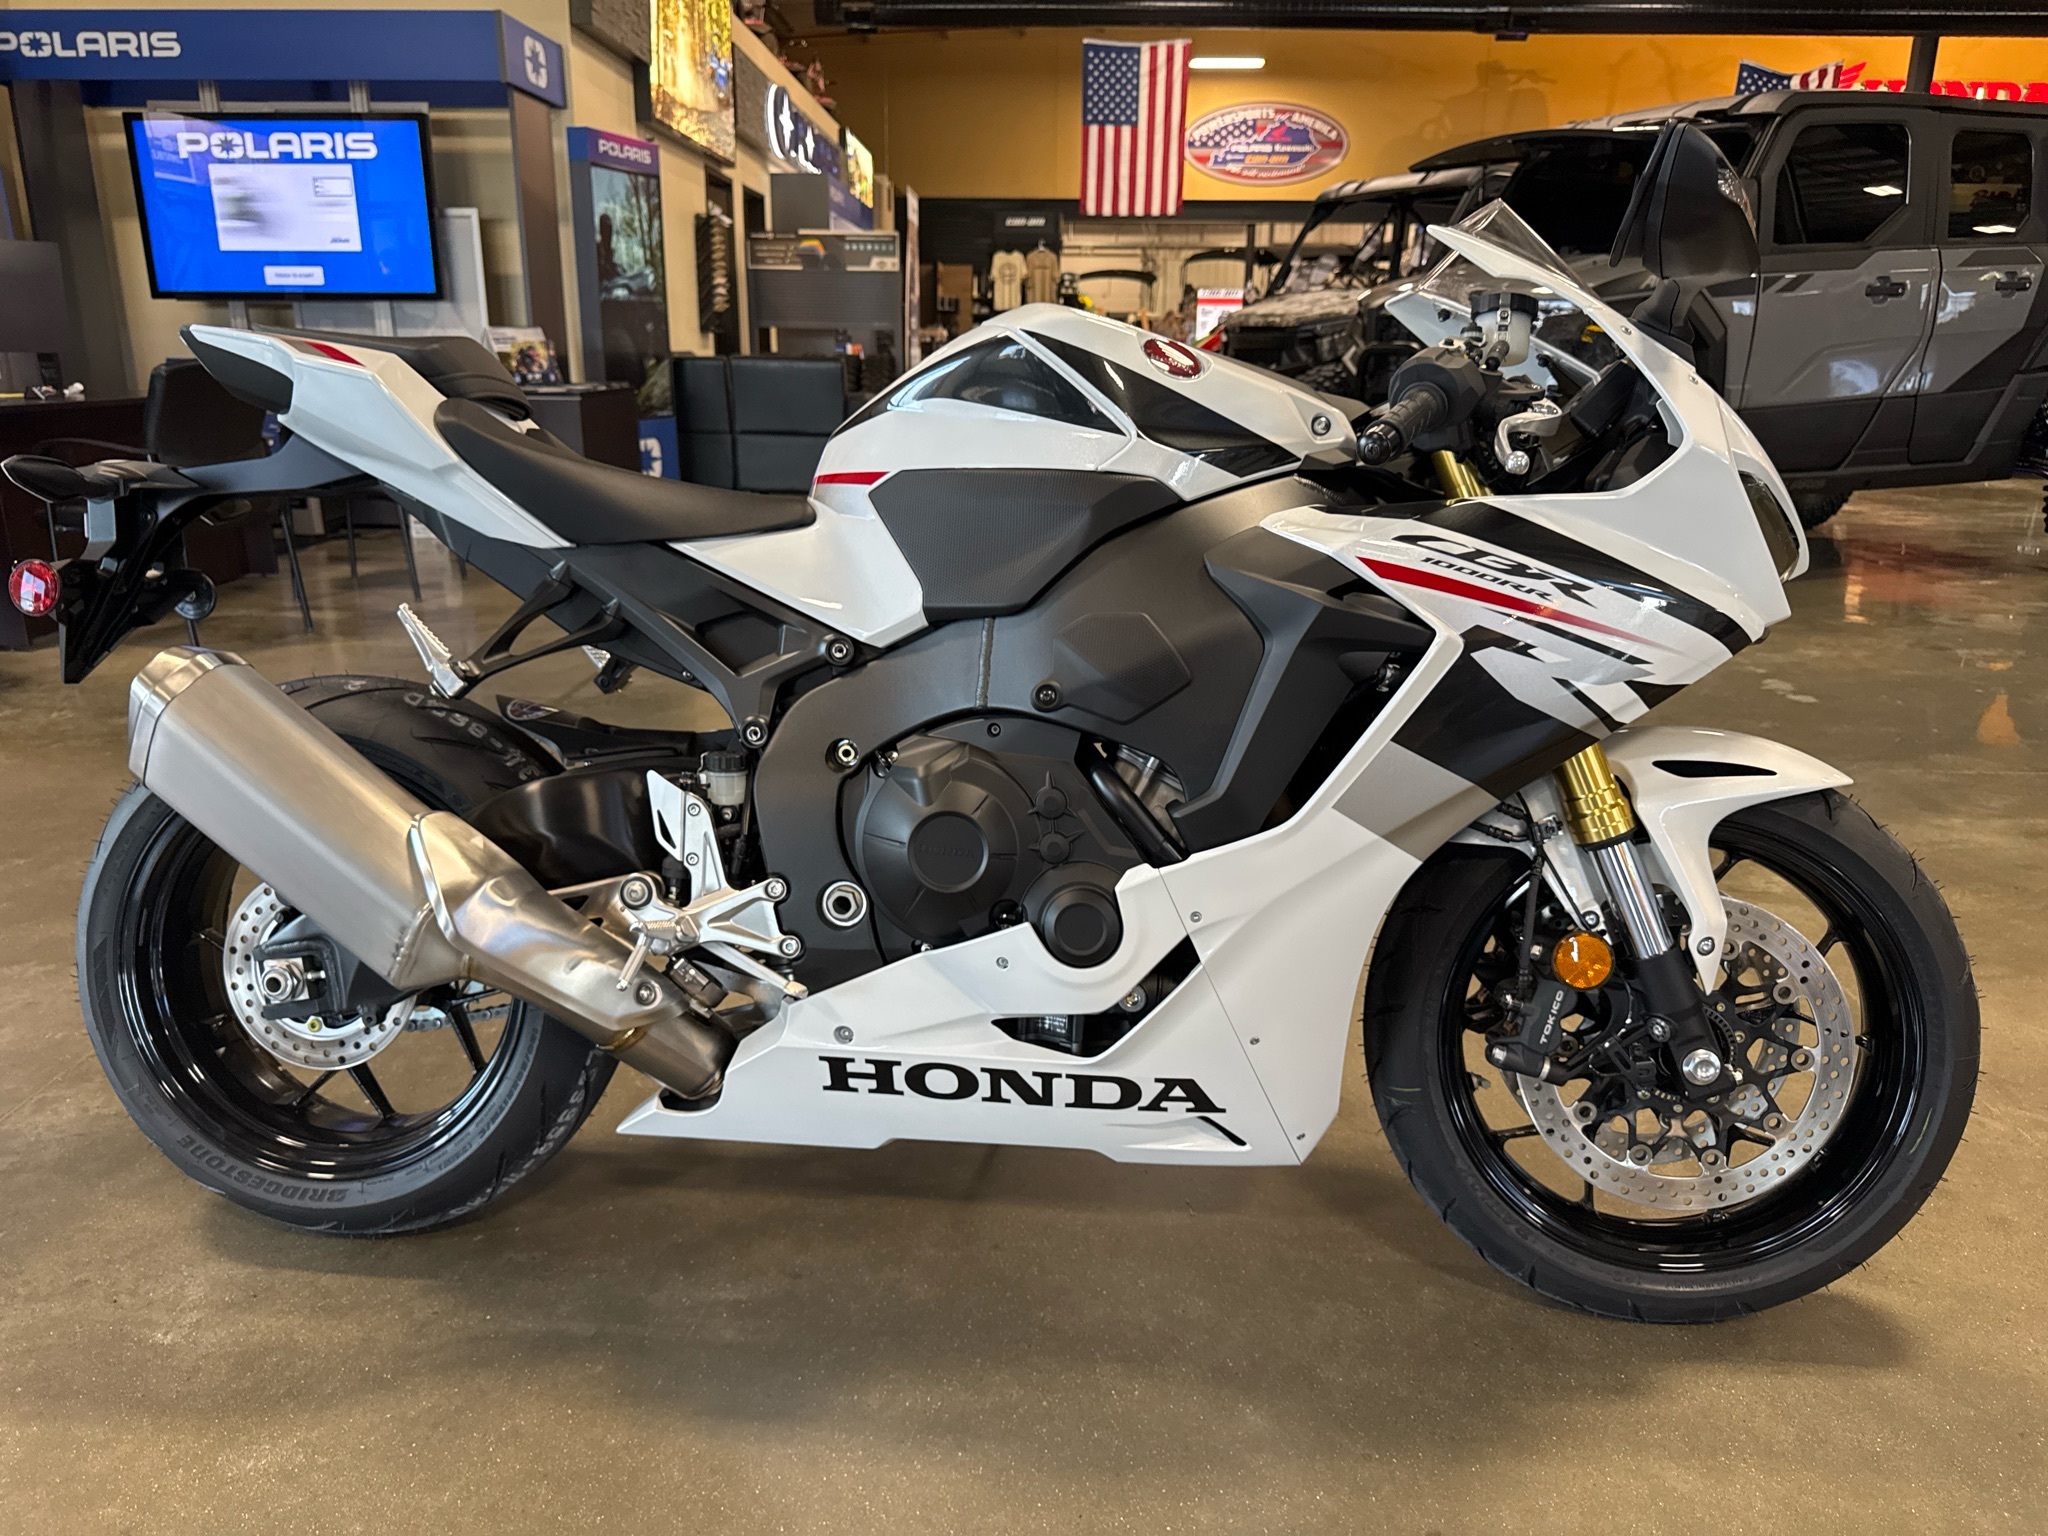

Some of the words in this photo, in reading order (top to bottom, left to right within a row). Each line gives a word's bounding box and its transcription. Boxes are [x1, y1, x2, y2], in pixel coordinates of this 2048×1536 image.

[0, 31, 181, 57] POLARIS
[176, 131, 378, 160] POLARIS
[597, 138, 652, 165] POLARIS
[1391, 534, 1598, 609] CBR
[1420, 556, 1554, 603] 1000RR
[1539, 989, 1565, 1045] TOKICO
[818, 1055, 1227, 1114] HONDA
[176, 1134, 350, 1203] BRIDGESTONE
